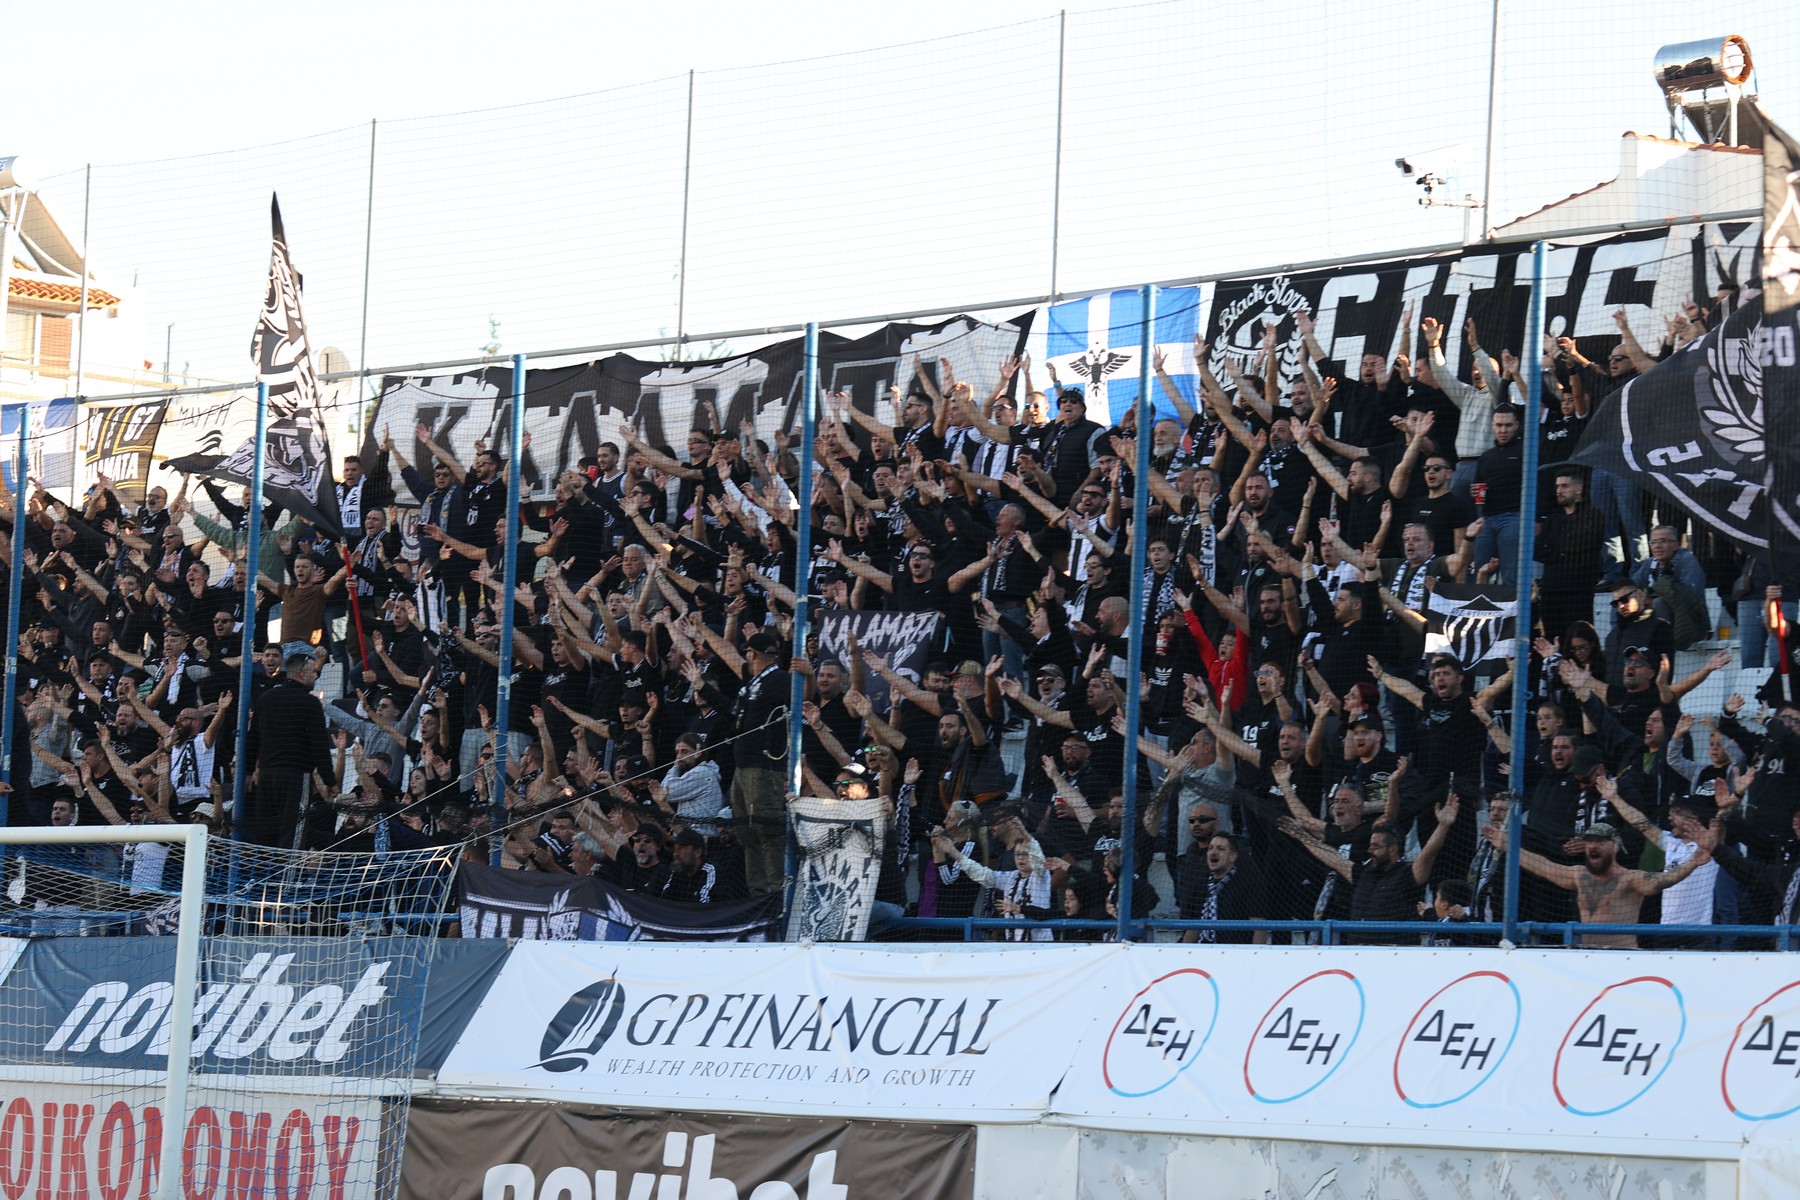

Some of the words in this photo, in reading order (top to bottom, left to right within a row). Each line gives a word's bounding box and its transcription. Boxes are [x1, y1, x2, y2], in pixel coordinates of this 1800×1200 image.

[1218, 281, 1267, 333] Black
[817, 611, 941, 654] KALAMATA
[43, 952, 392, 1062] novibet
[1122, 1003, 1195, 1061] ΔΕΗ
[1263, 1007, 1341, 1065] ΔΕΗ
[1413, 1009, 1496, 1070] ΔΕΗ
[1573, 1014, 1661, 1076] ΔΕΗ
[1742, 1015, 1800, 1078] ΔΕ
[606, 1057, 685, 1077] WEALTH
[689, 1060, 818, 1083] PROTECTION
[825, 1066, 871, 1085] AND
[882, 1068, 978, 1088] GROWTH
